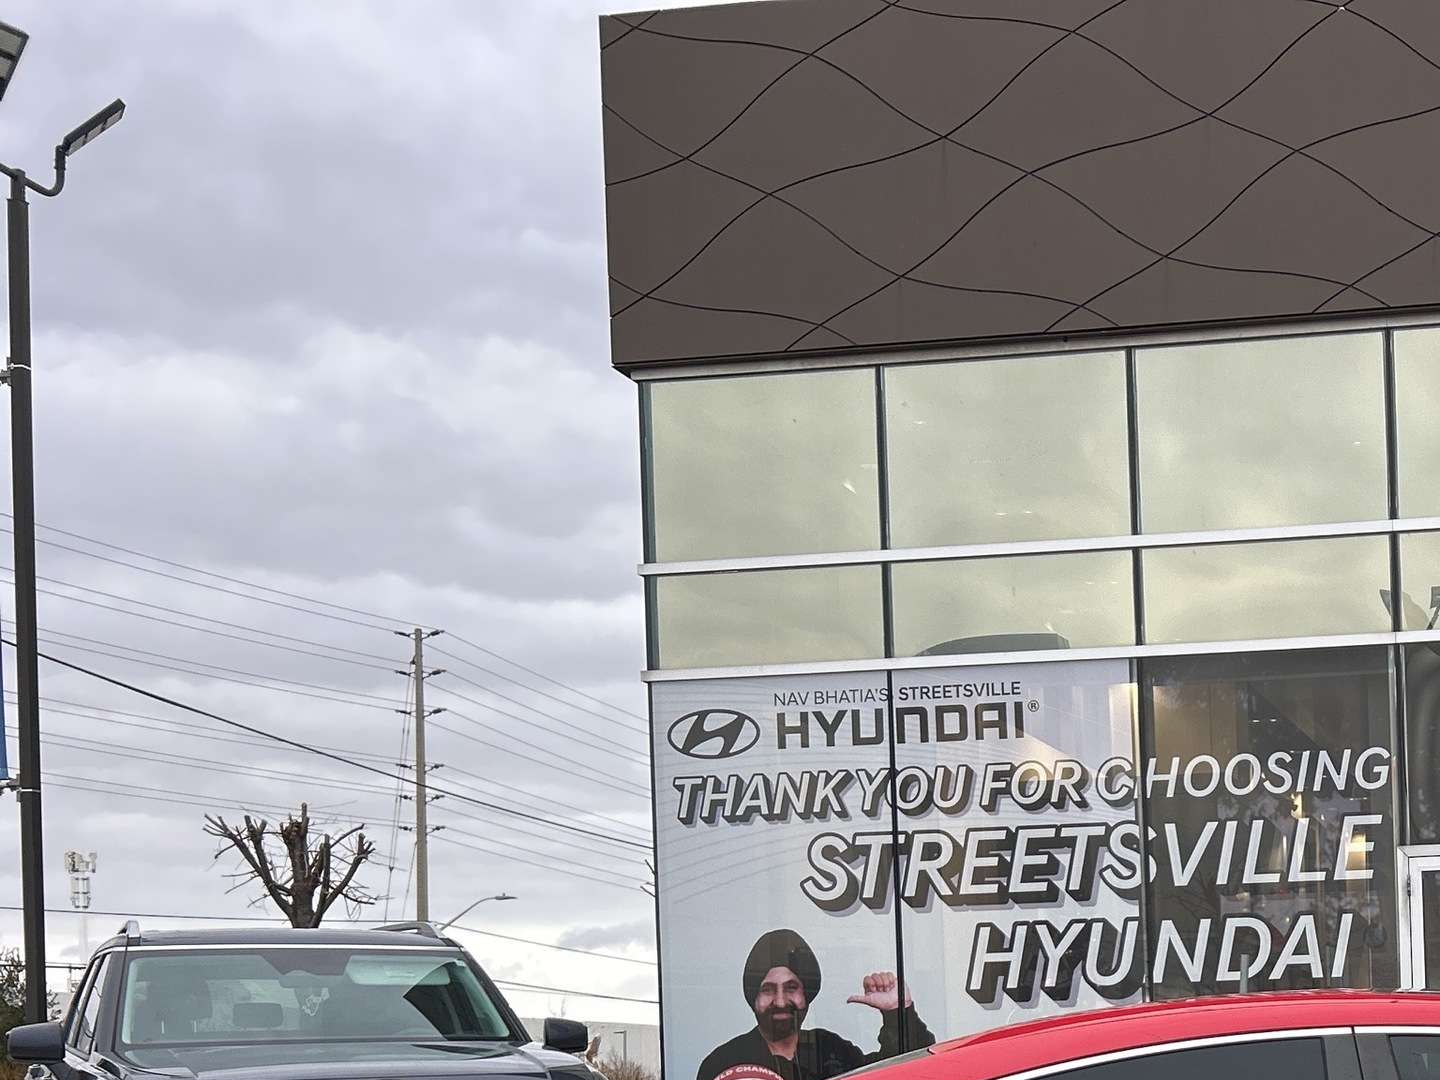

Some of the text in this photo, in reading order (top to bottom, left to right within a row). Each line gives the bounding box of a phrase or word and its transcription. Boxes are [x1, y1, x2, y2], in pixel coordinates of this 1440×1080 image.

[774, 680, 1022, 707] NAV BHATIA'S STREETSVILLE
[673, 746, 1392, 821] THANK YOU FOR CHOOSING
[801, 813, 1384, 902] STREETSVILLE
[967, 912, 1354, 991] HYUNDAI
